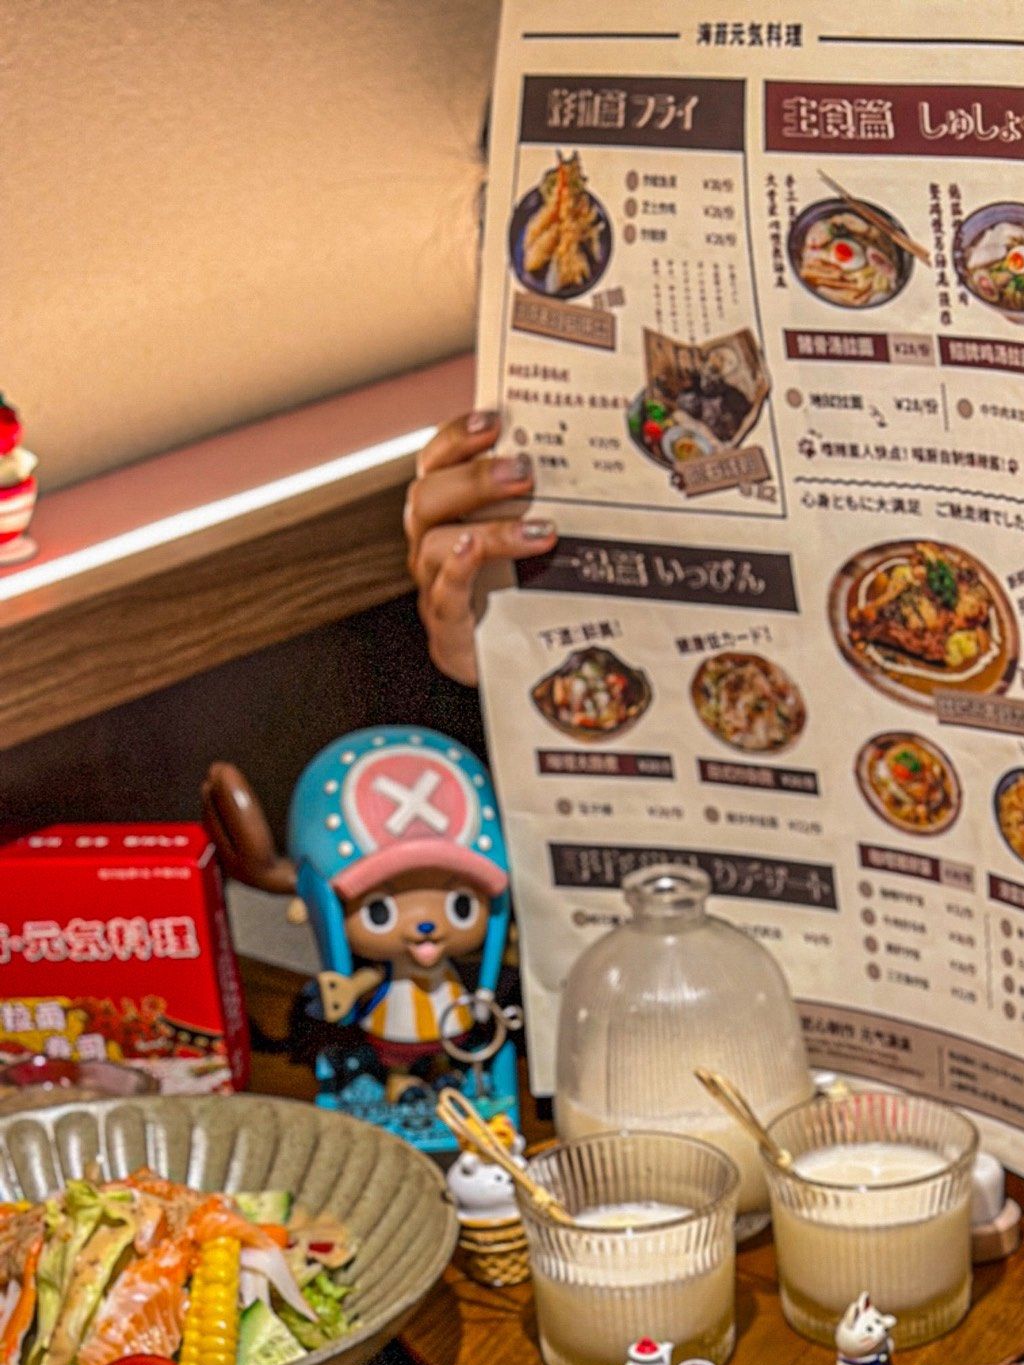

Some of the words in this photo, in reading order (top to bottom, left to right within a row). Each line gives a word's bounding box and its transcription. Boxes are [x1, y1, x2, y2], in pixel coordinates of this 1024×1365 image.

[781, 96, 895, 139] 主食篇
[654, 556, 766, 597] いっぴん
